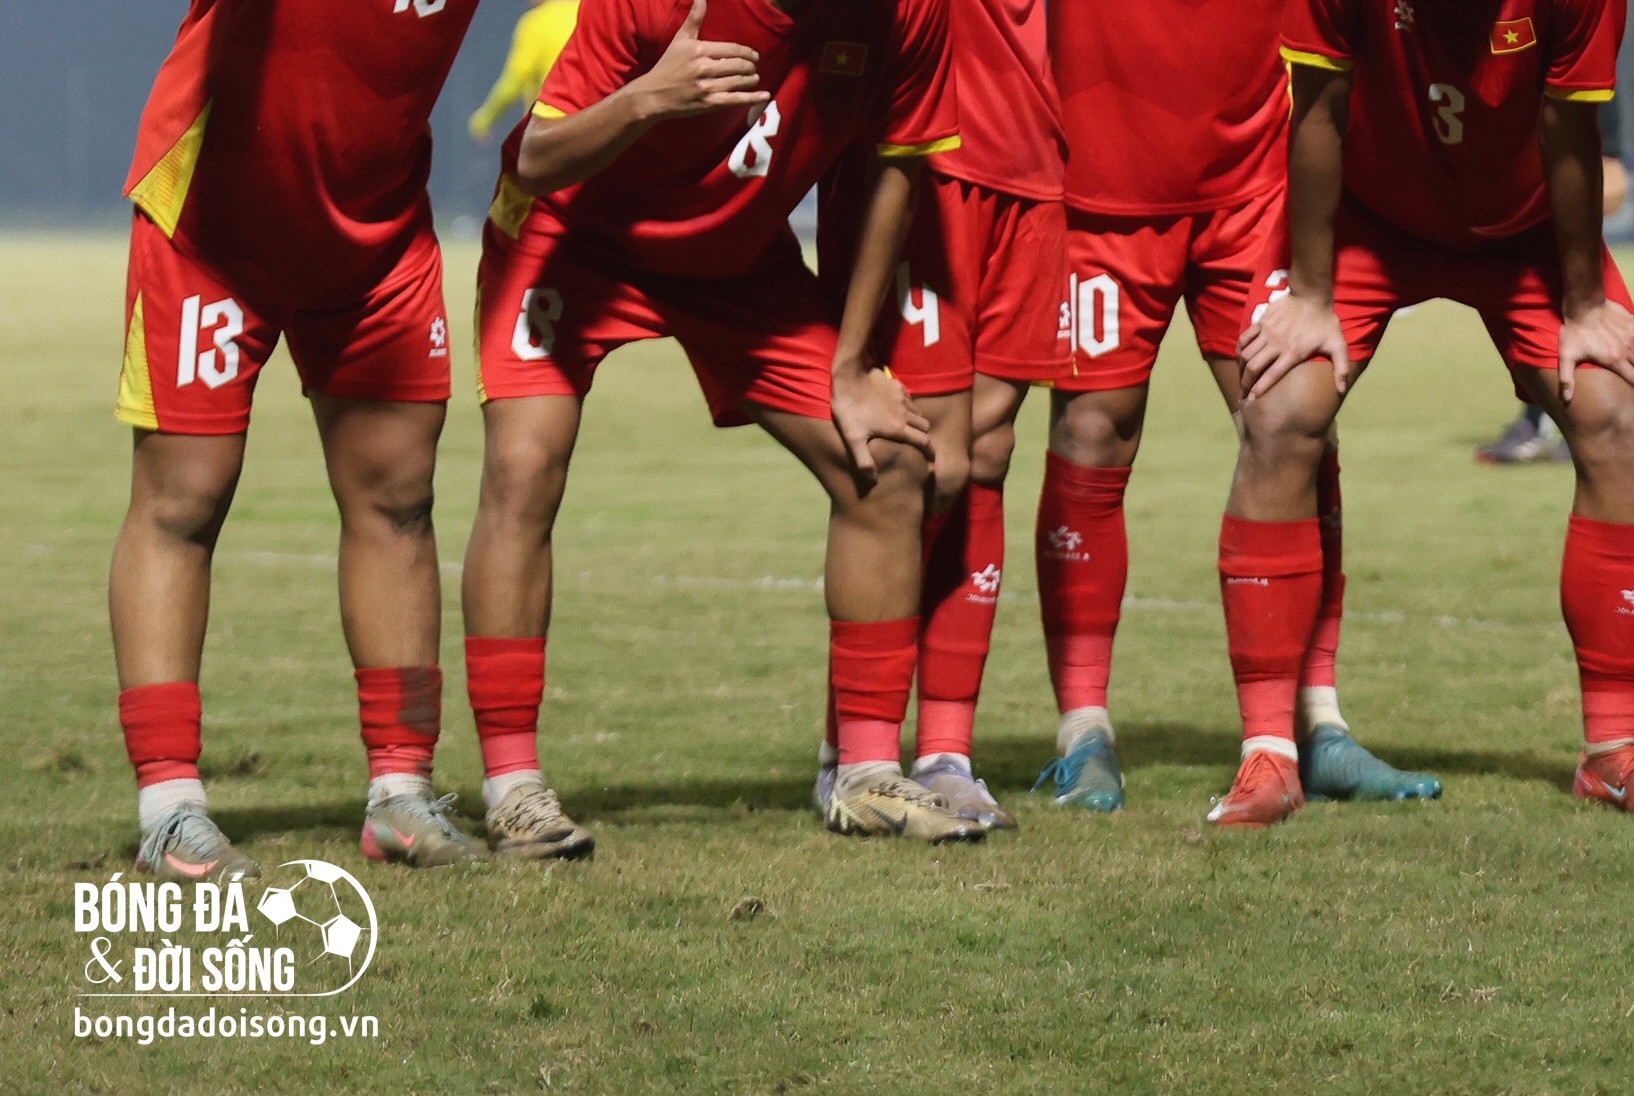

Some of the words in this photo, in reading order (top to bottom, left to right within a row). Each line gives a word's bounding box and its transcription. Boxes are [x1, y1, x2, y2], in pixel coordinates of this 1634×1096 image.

[728, 100, 781, 177] 8
[1428, 84, 1465, 144] 3
[177, 294, 244, 389] 13
[511, 288, 563, 360] 8
[897, 262, 940, 348] 4
